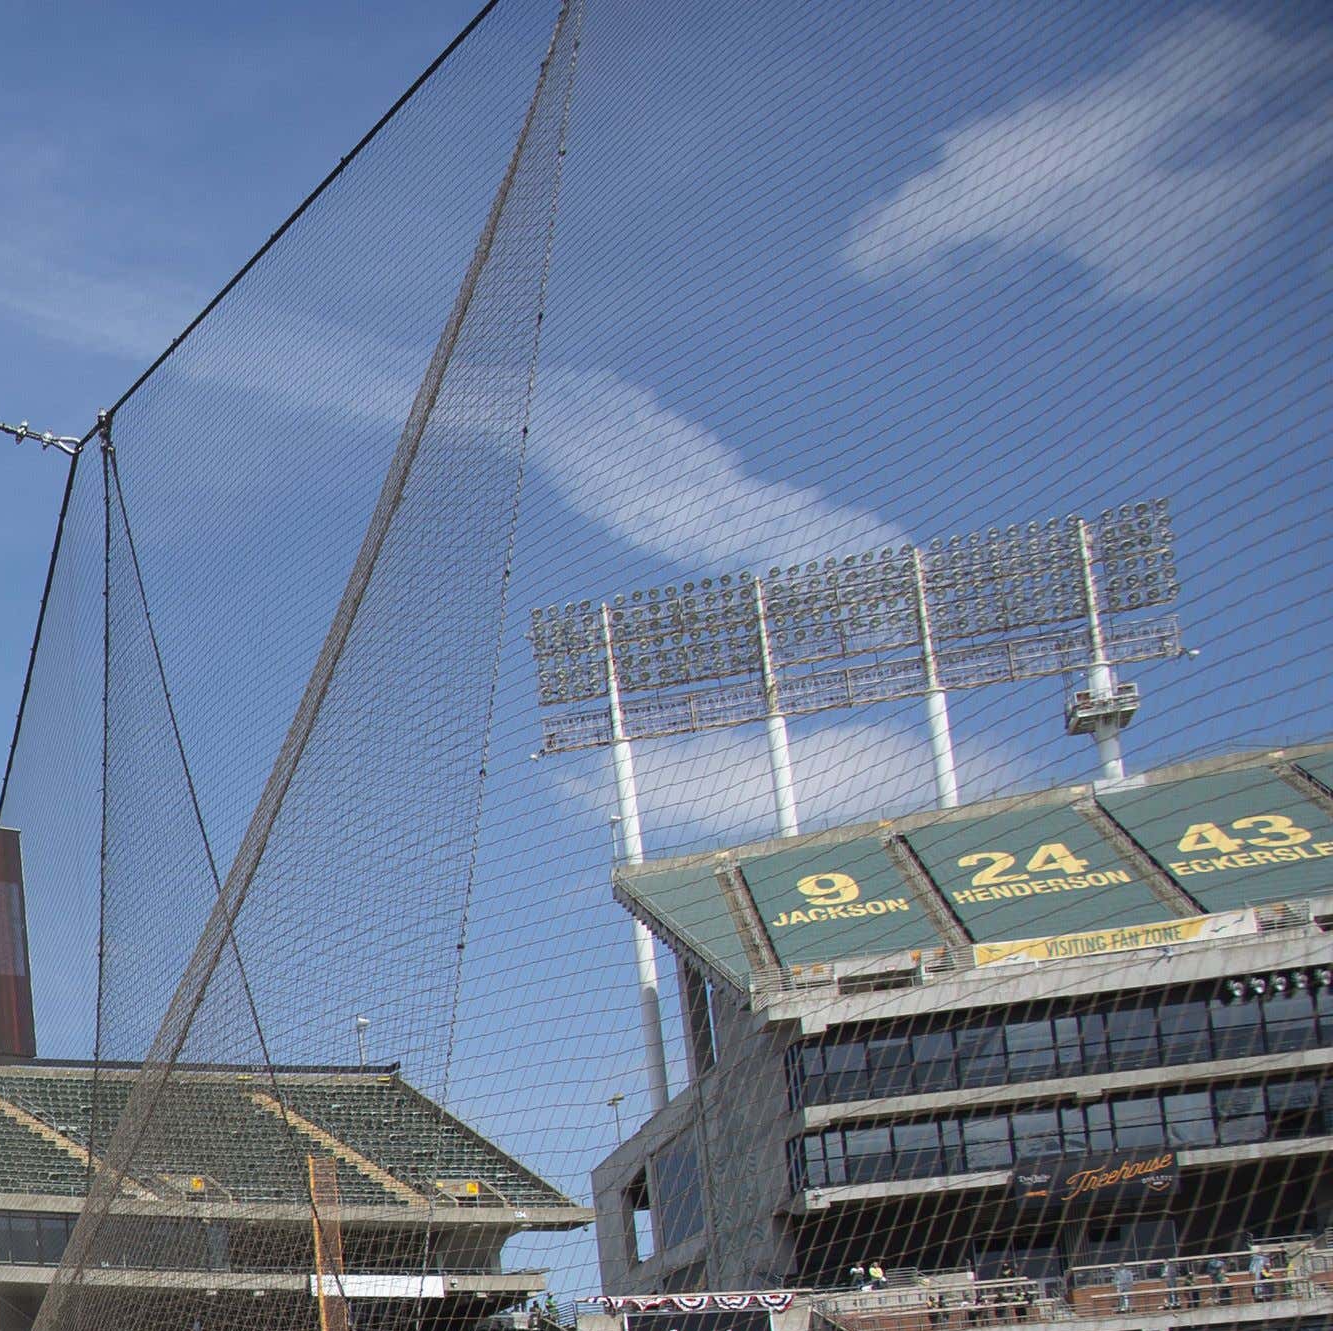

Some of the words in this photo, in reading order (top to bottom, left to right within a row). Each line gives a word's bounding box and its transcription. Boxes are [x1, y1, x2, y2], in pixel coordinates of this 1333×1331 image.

[1176, 815, 1313, 858] 43
[957, 843, 1090, 886] 24
[796, 871, 861, 906] 9
[952, 869, 1132, 905] HENDERSON
[772, 897, 910, 928] JACKSON
[1044, 936, 1107, 957] VISITING
[1111, 929, 1140, 949] FAN
[1144, 926, 1182, 945] ZONE
[1061, 1153, 1173, 1200] Treehouse
